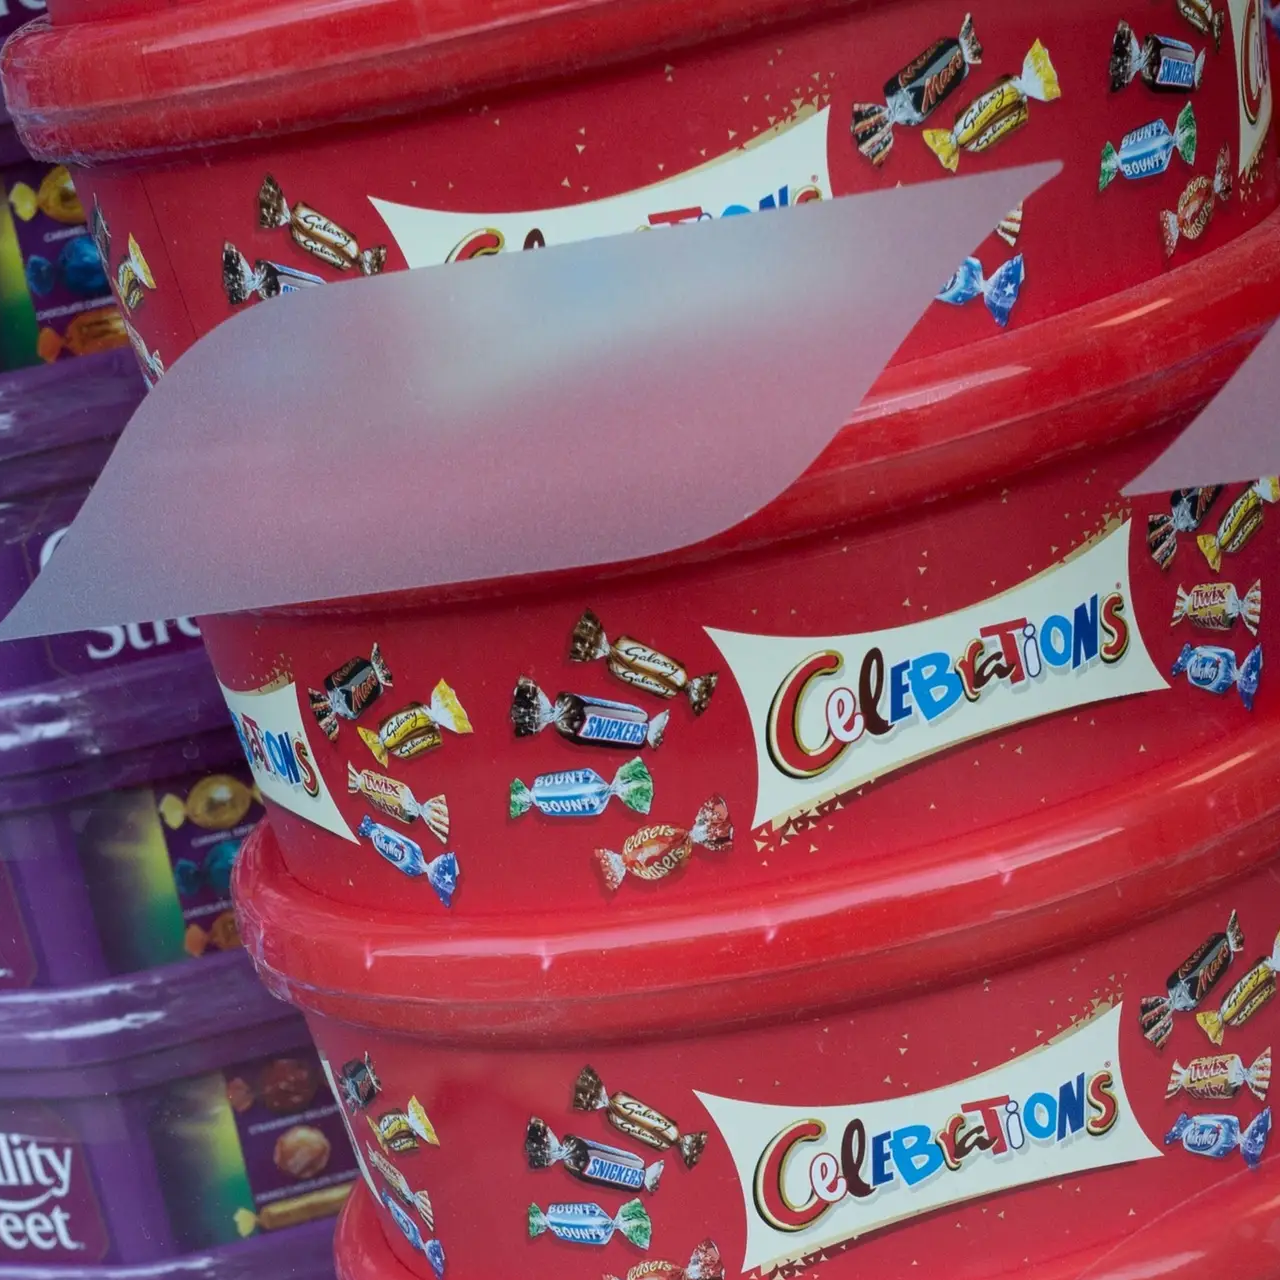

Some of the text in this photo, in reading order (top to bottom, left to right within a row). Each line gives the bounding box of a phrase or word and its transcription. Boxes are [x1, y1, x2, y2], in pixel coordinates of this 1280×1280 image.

[922, 50, 963, 113] Mars
[1159, 57, 1195, 85] SNICKERS
[963, 87, 1006, 130] Galaxy
[1120, 121, 1165, 149] BOUNTY
[1123, 152, 1170, 176] BOUNTY
[303, 215, 351, 248] Galaxy
[303, 239, 345, 268] Galaxy
[624, 646, 679, 674] Galaxy
[352, 668, 378, 712] Mars
[621, 670, 670, 695] Galaxy
[385, 708, 418, 738] Galaxy
[583, 717, 646, 742] SNICKERS
[534, 768, 595, 786] BOUNTY
[540, 797, 599, 814] BOUNTY
[1195, 940, 1231, 1000] Mars
[623, 1103, 672, 1130] Galaxy
[621, 1124, 665, 1147] Galaxy
[588, 1160, 643, 1187] SNICKERS
[547, 1203, 601, 1219] BOUNTY
[554, 1226, 605, 1241] BOUNTY
